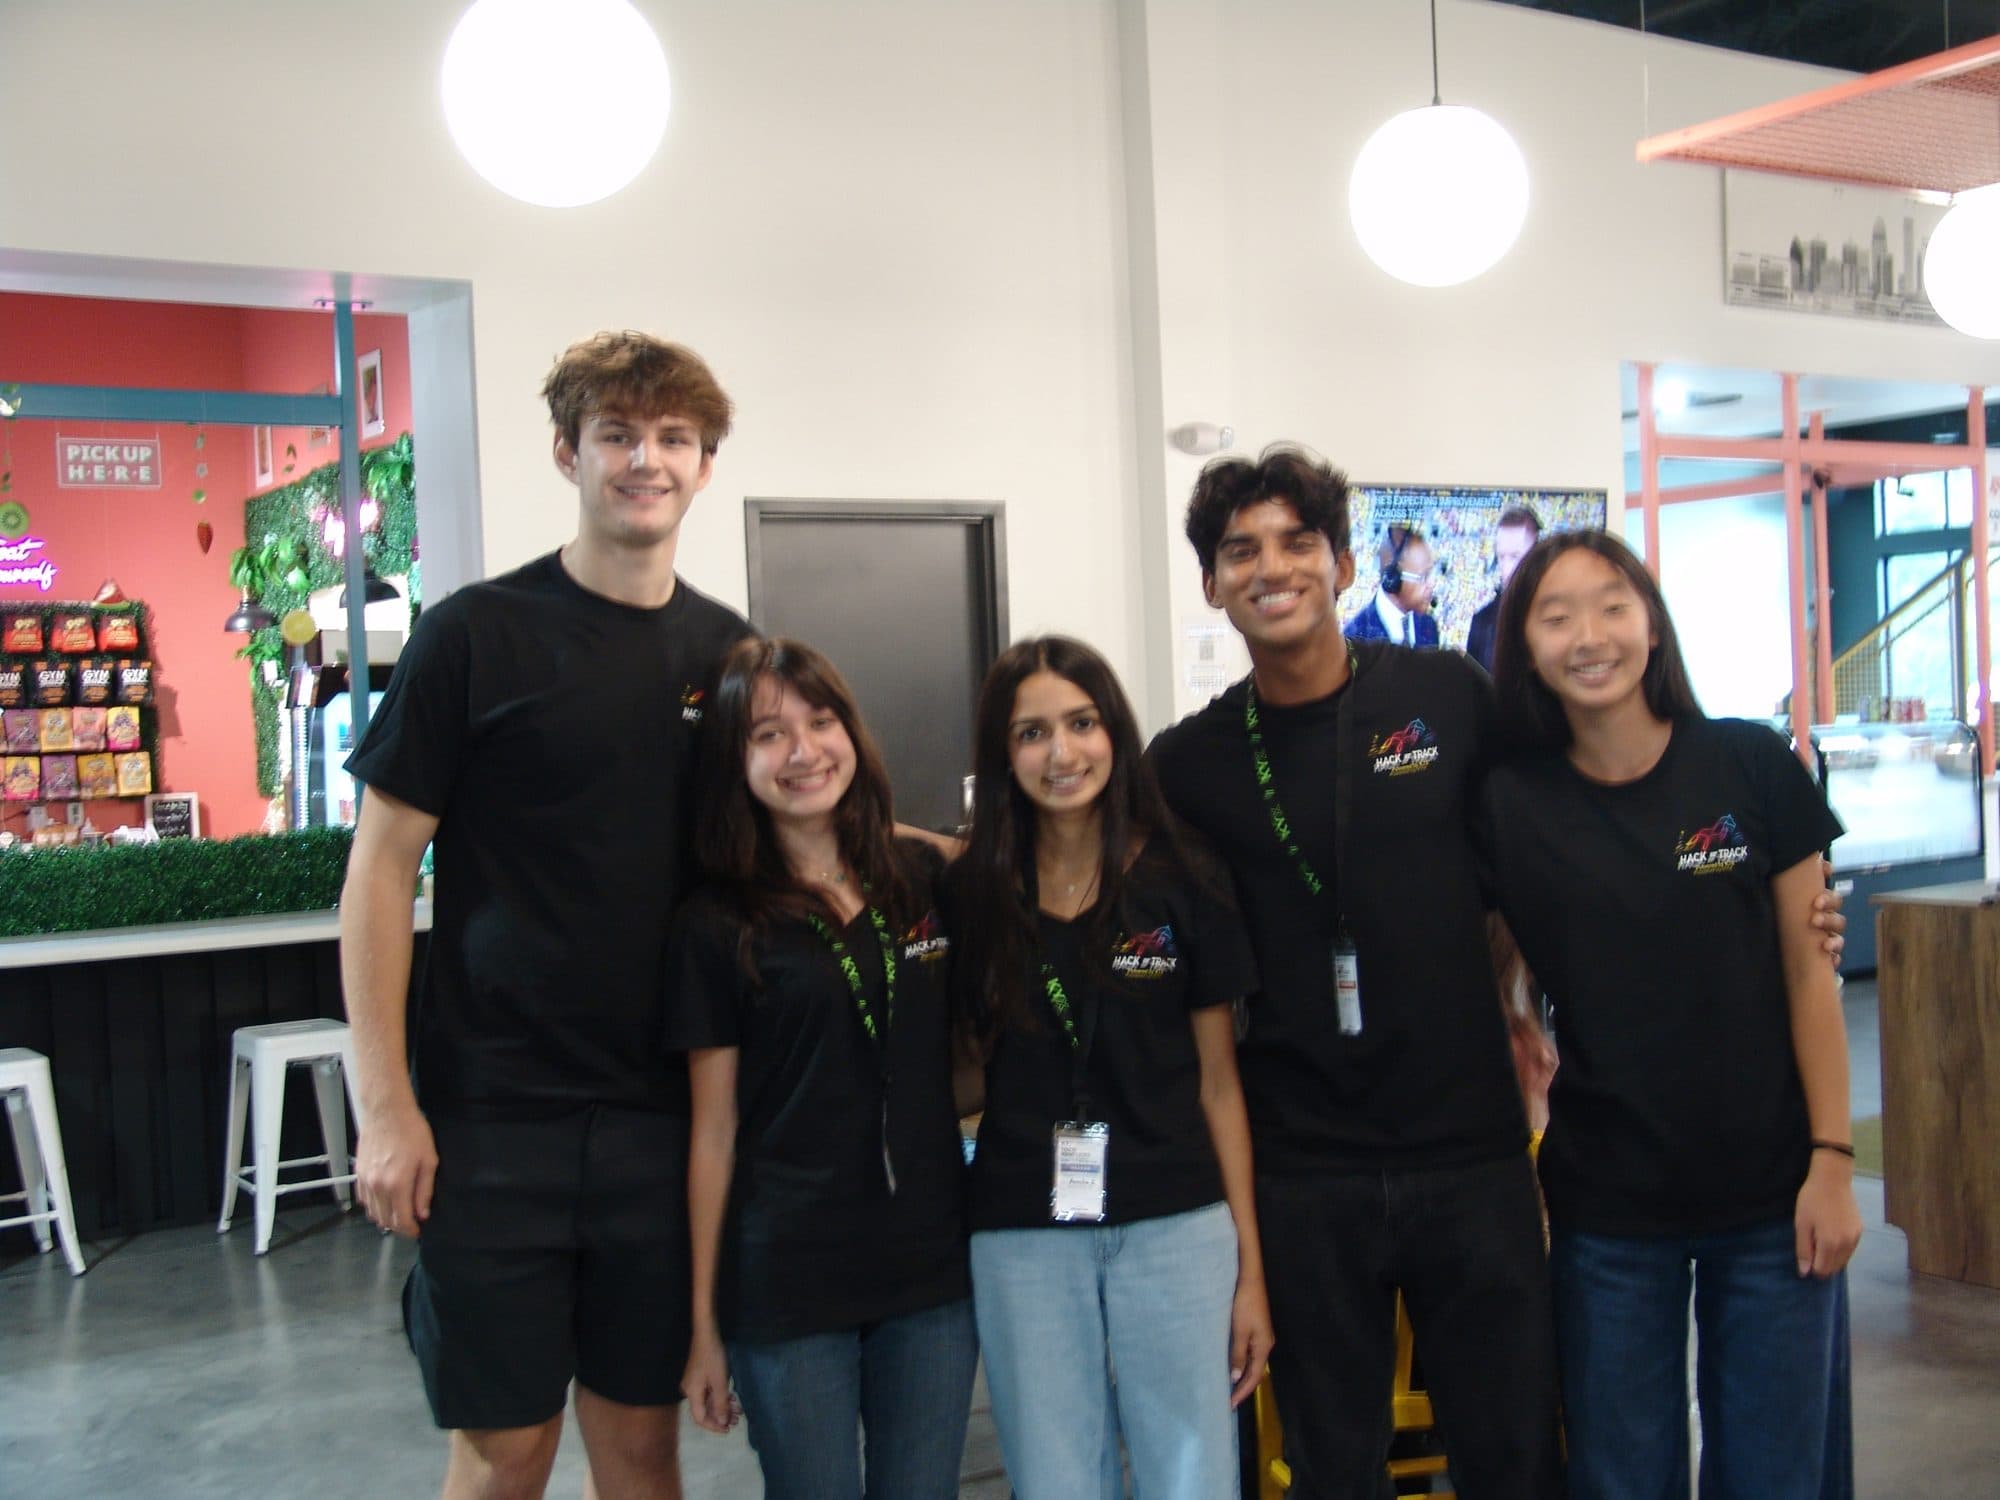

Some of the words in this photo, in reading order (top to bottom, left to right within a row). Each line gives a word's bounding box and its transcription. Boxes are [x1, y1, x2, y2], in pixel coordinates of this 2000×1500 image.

[67, 445, 120, 462] PICK
[123, 446, 152, 462] UP
[1374, 753, 1402, 771] HACK
[1411, 746, 1439, 761] TRACK
[1678, 851, 1707, 869] HACK
[1718, 846, 1748, 862] TRACK
[1112, 955, 1141, 969] HACK
